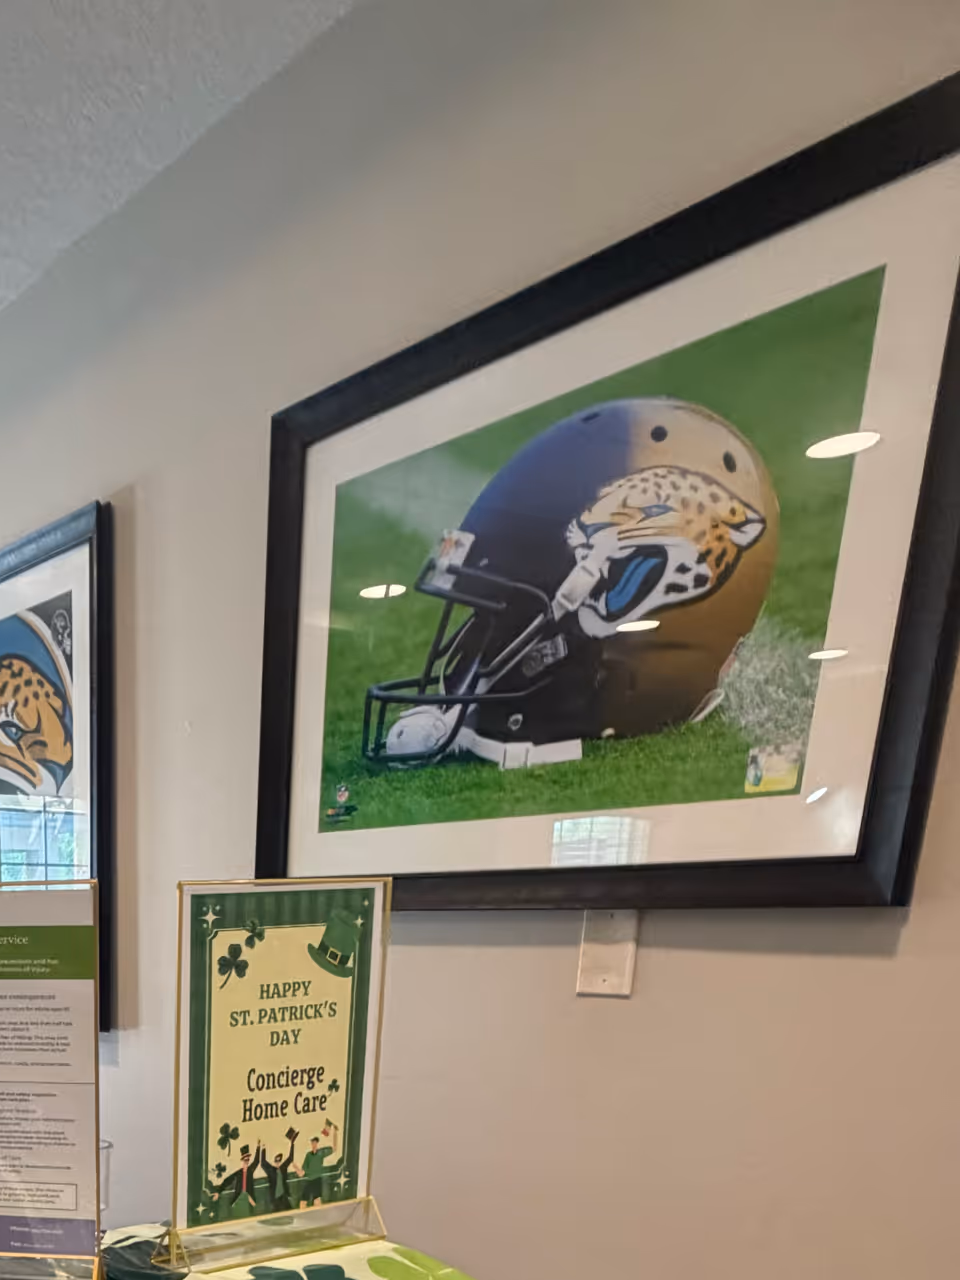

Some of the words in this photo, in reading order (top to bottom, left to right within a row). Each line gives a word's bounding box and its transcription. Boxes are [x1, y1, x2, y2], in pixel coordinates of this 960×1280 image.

[258, 980, 312, 1000] HAPPY
[229, 1009, 255, 1028] ST.
[256, 1000, 338, 1025] PATRICK'S
[269, 1028, 302, 1047] DAY
[247, 1065, 325, 1093] Concierge
[242, 1098, 289, 1123] Home
[294, 1091, 327, 1115] Care
